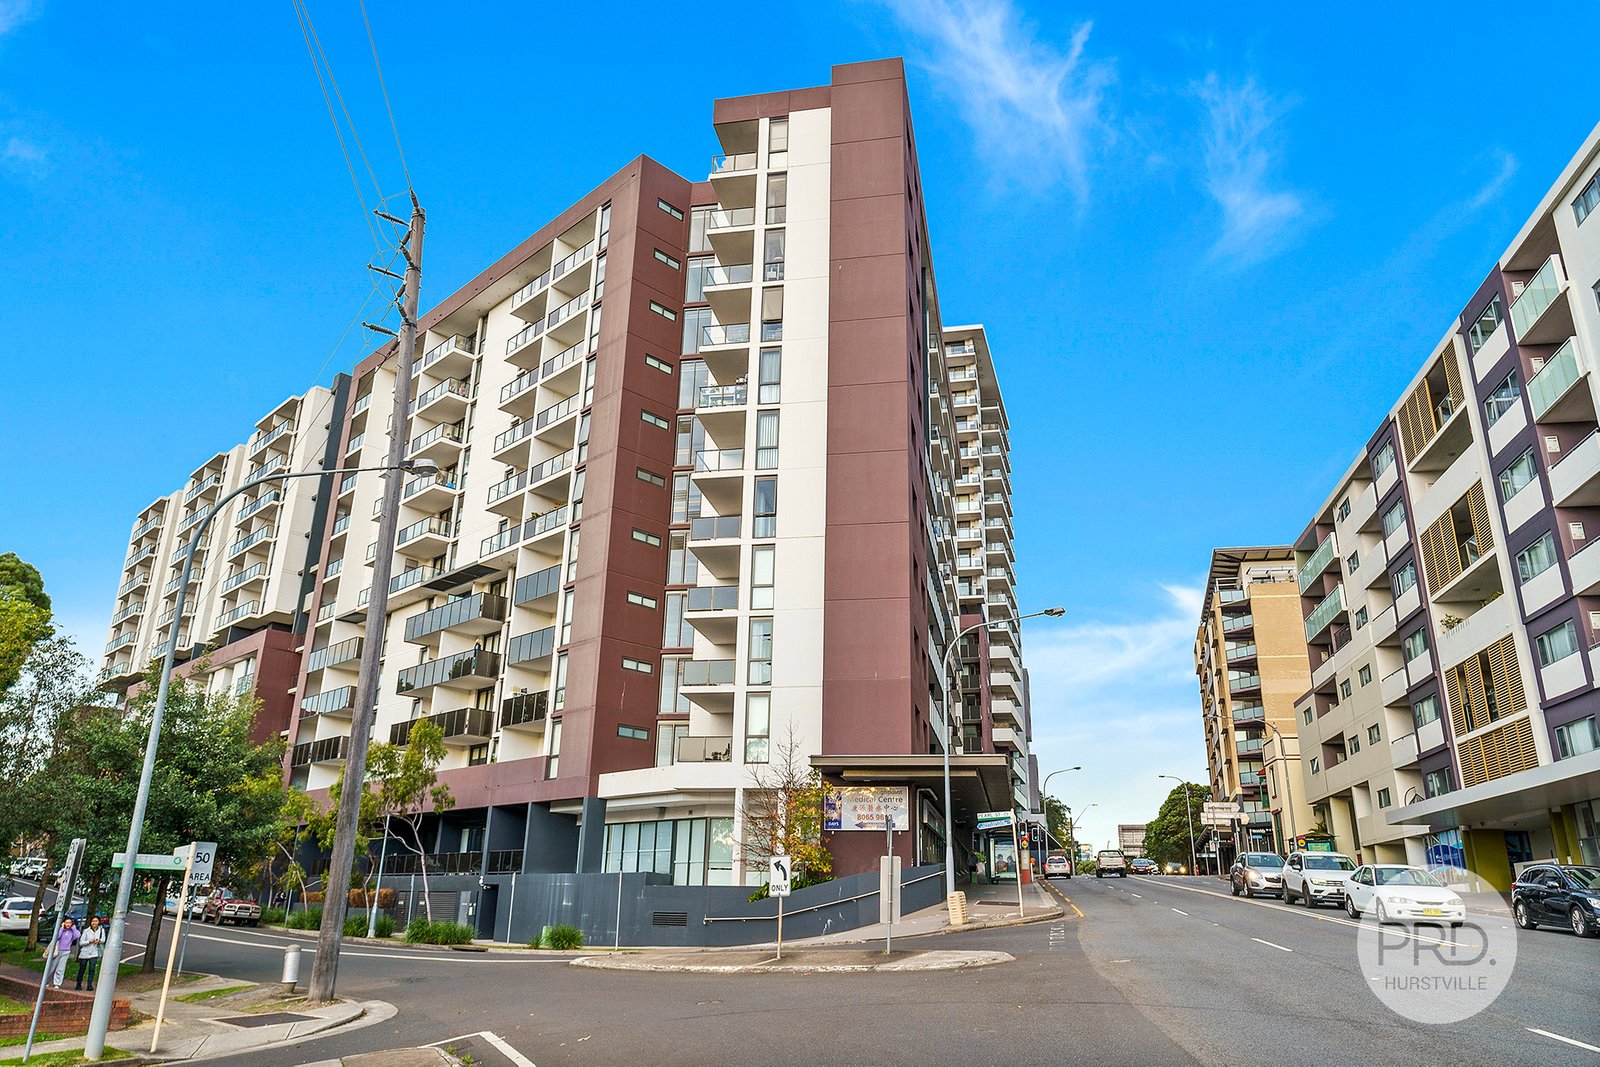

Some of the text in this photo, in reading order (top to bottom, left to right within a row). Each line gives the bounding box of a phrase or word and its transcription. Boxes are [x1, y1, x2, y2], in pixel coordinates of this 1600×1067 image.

[878, 795, 903, 803] Centre
[857, 813, 874, 821] 8065
[195, 852, 211, 864] 50
[189, 872, 210, 881] AREA
[771, 884, 789, 892] ONLY
